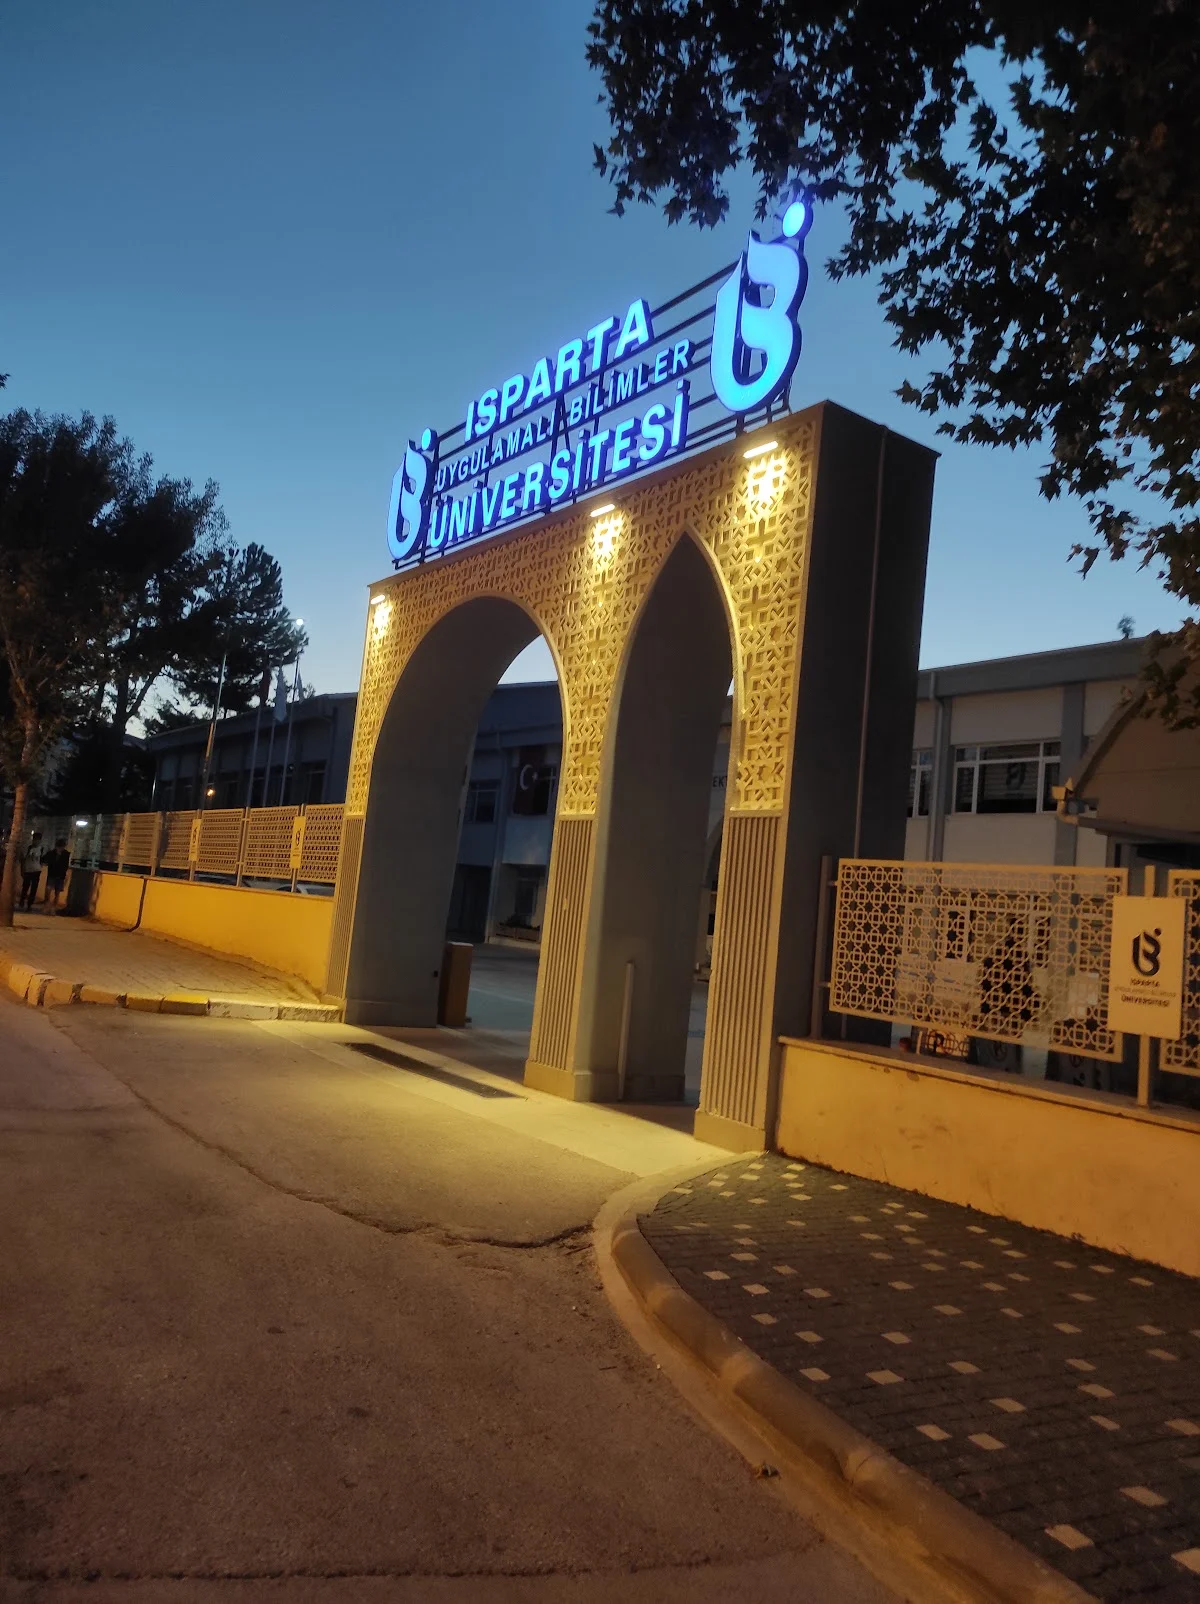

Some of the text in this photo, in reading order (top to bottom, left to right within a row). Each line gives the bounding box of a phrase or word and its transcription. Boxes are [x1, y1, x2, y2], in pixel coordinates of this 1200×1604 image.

[436, 338, 692, 492] UYGULAMALI BİLİMLER
[464, 298, 653, 442] ISPARTA
[430, 379, 689, 548] ÜNİVERSİTESİ
